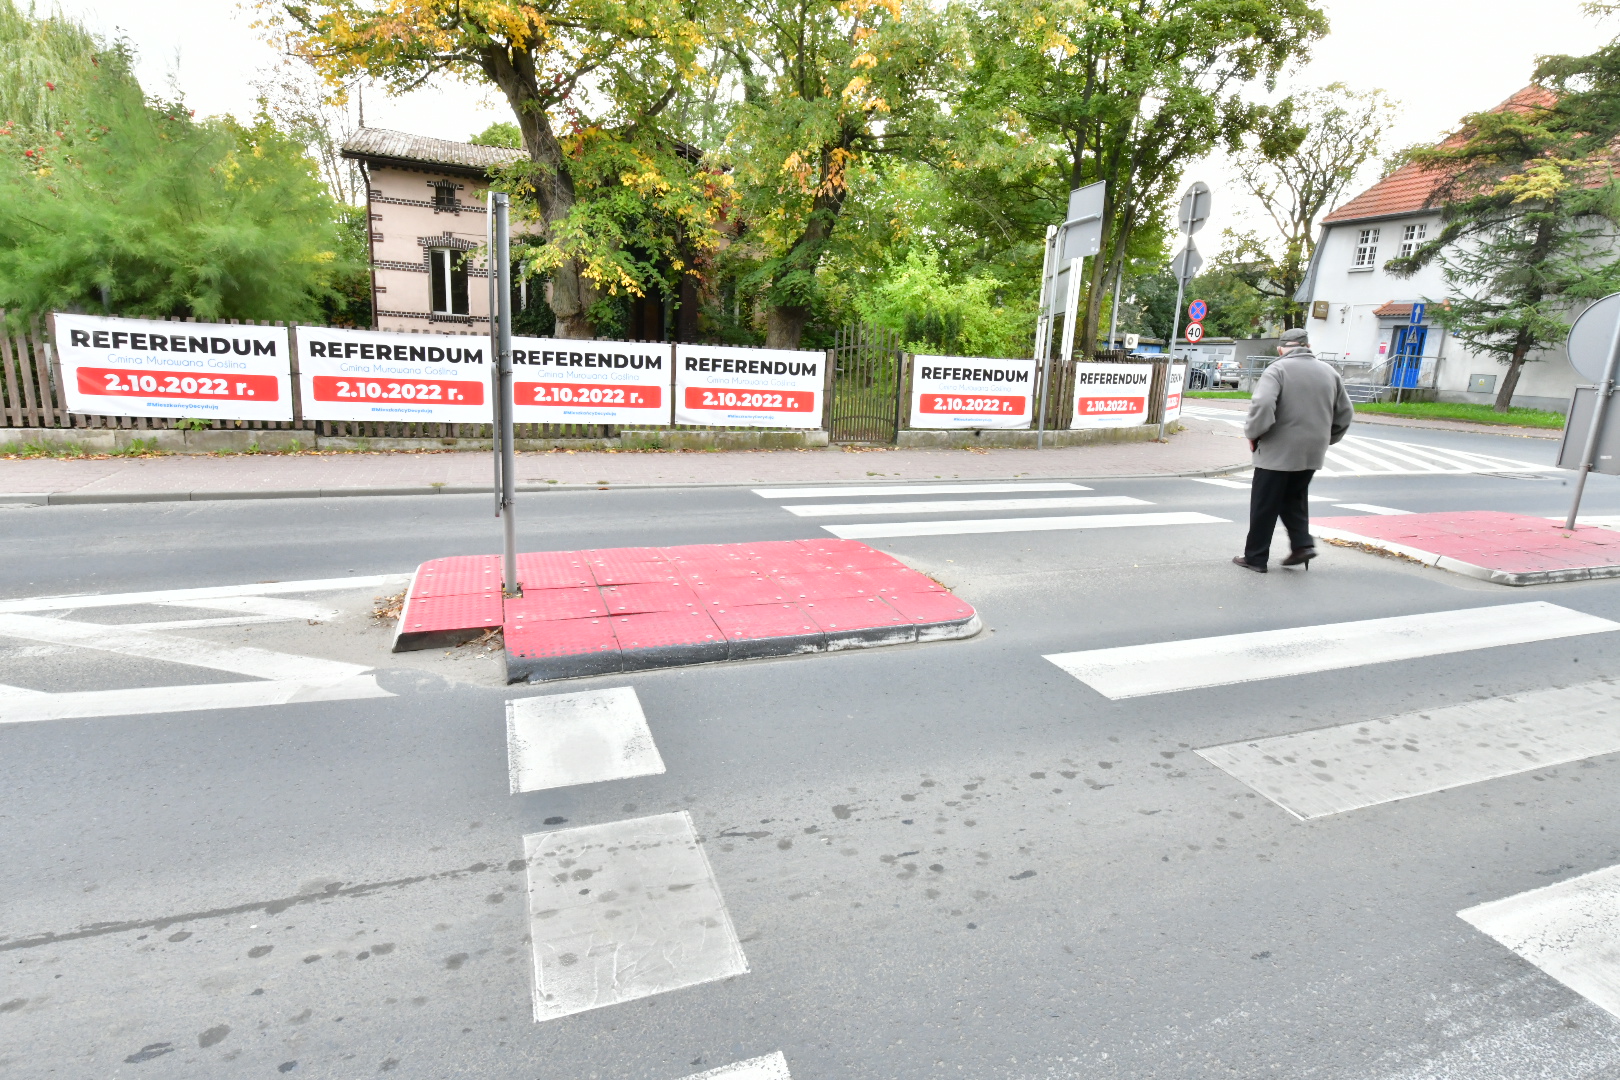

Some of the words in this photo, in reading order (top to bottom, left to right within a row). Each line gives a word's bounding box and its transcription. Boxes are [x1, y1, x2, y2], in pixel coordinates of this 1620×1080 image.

[1188, 328, 1200, 338] 40
[70, 329, 276, 356] REFERENDUM
[310, 341, 482, 364] REFERENDUM
[512, 350, 661, 369] REFERENDUM
[107, 354, 142, 364] Gmina
[147, 356, 203, 367] Murowana
[208, 358, 246, 369] Goślina
[340, 363, 370, 373] Gmina
[374, 364, 421, 375] Murowana
[685, 357, 816, 376] REFERENDUM
[538, 370, 563, 378] Gmina
[567, 371, 608, 380] Murowana
[921, 367, 1028, 382] REFERENDUM
[1080, 373, 1147, 384] REFERENDUM
[104, 374, 229, 394] 2.10.2022
[236, 382, 254, 396] r.
[336, 381, 442, 400] 2.10.2022
[448, 388, 463, 400] r.
[534, 387, 624, 403] 2.10.2022
[630, 392, 644, 404] r.
[703, 392, 782, 407] 2.10.2022
[787, 397, 798, 408] r.
[934, 398, 999, 411] 2.10.2022
[1003, 402, 1013, 411] r.
[1086, 400, 1127, 412] 2.10.2022
[1129, 402, 1136, 410] r.
